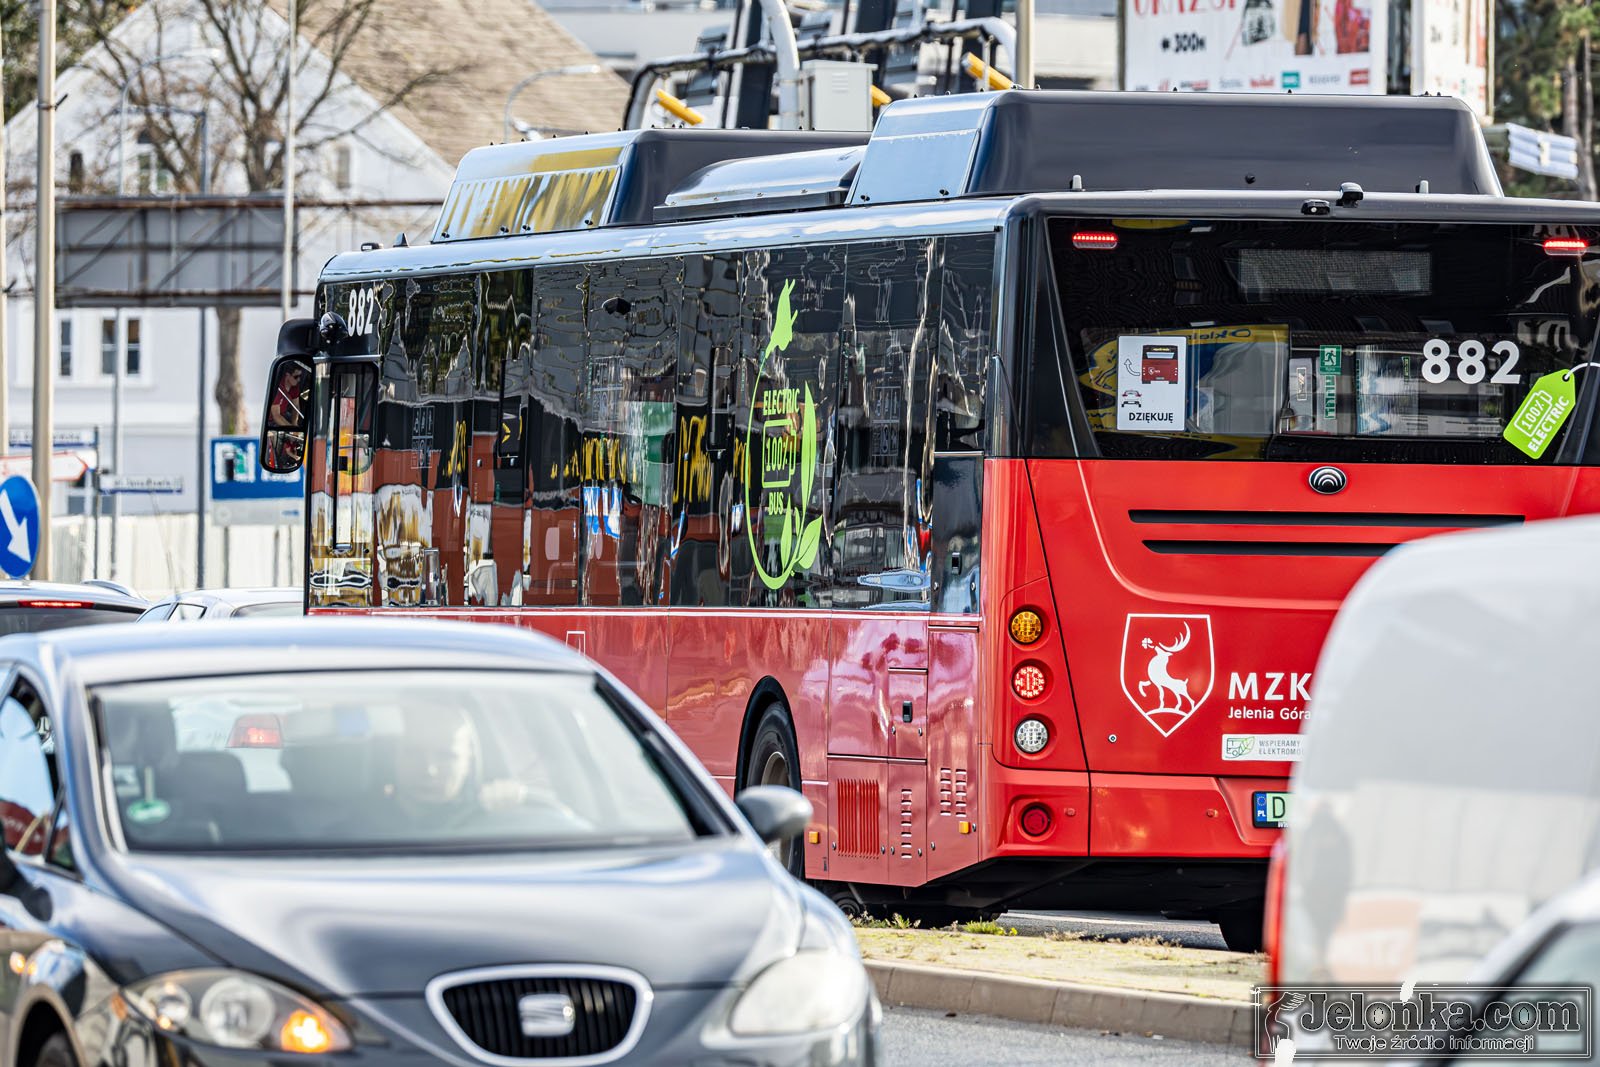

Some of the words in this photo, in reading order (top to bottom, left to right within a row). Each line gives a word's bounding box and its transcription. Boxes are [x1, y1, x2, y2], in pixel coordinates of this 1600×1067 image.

[348, 287, 374, 337] 882
[1421, 338, 1521, 385] 882
[762, 388, 800, 416] ELECTRIC
[1521, 399, 1545, 430] 100%
[1128, 412, 1174, 424] DZIĘKUJĘ
[1527, 395, 1570, 453] ELECTRIC
[765, 435, 788, 472] 100%
[768, 491, 785, 516] BUS
[1228, 671, 1313, 701] MZK
[1228, 706, 1275, 719] Jelenia
[1279, 706, 1312, 720] Góra
[1258, 739, 1301, 747] WSPIERAMY
